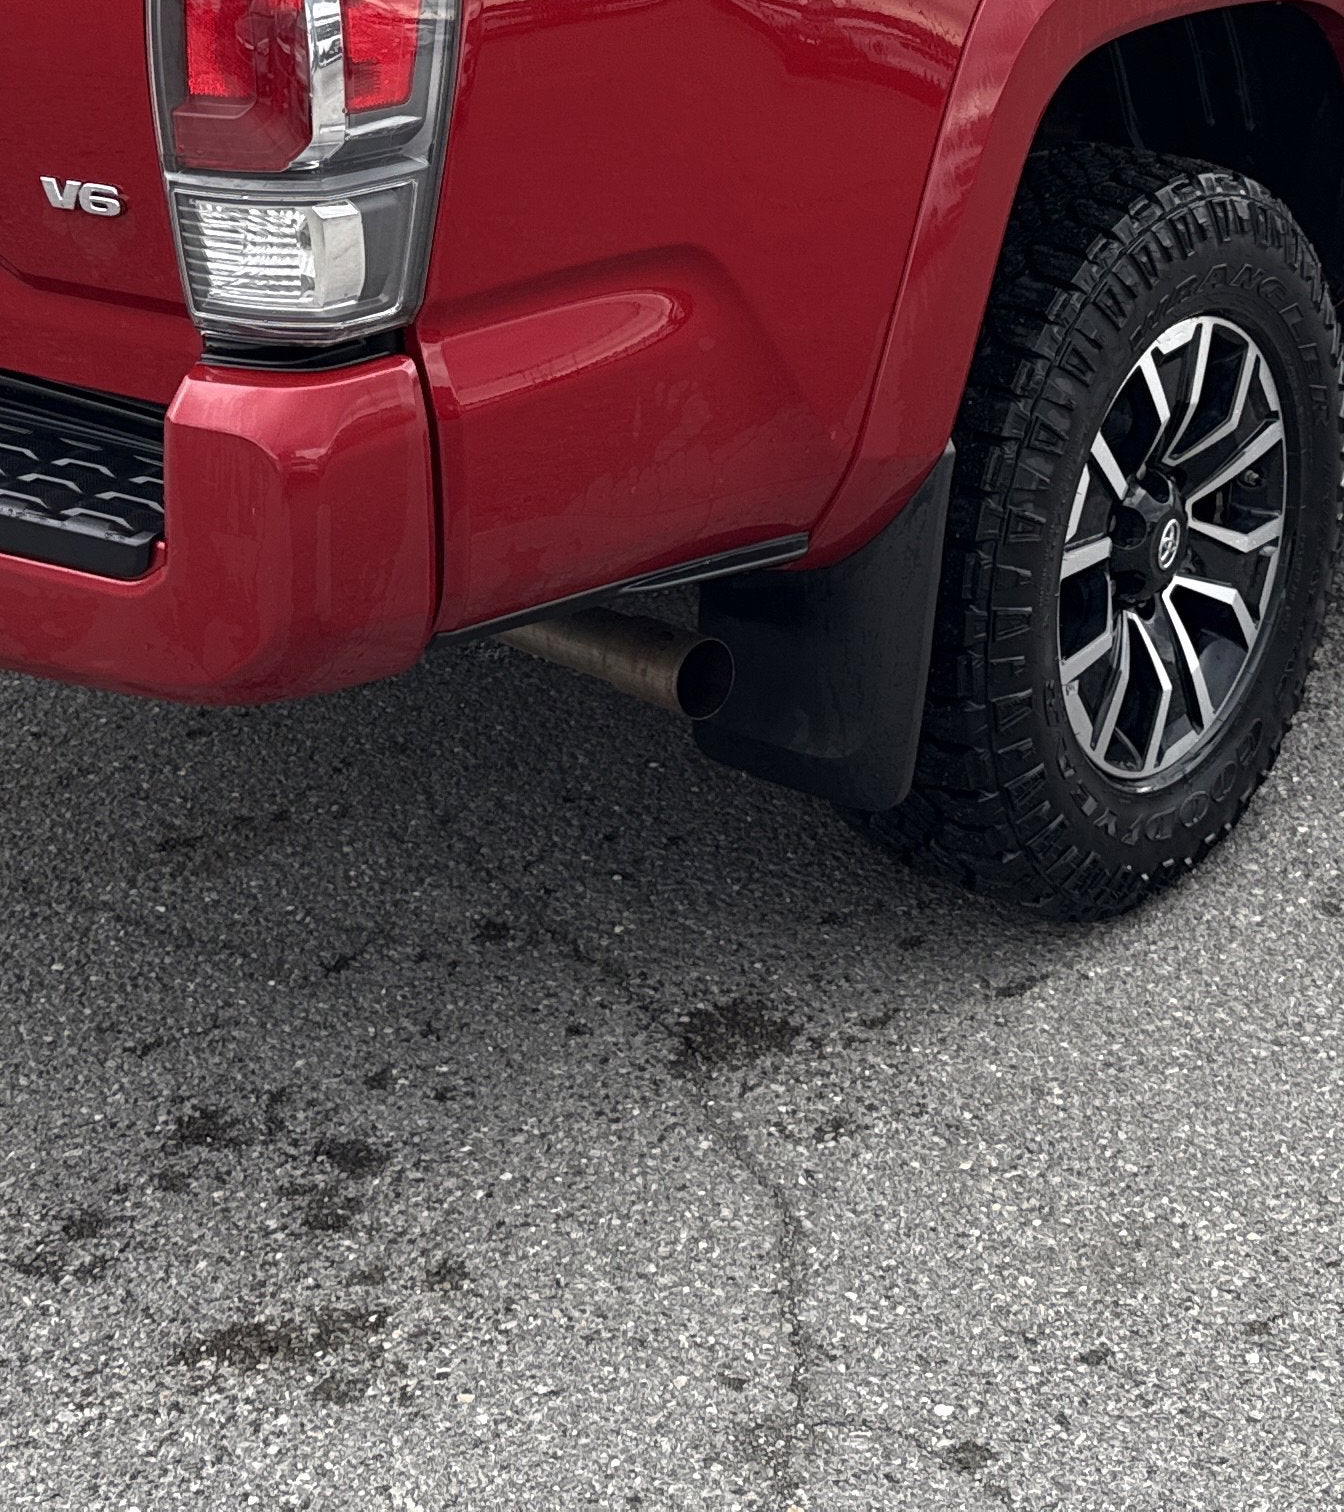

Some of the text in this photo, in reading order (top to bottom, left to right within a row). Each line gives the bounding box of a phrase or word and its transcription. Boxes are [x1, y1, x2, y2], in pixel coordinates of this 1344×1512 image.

[39, 175, 122, 217] V6
[1129, 263, 1329, 426] WRANGLER
[1042, 678, 1264, 846] GOODYEAR
